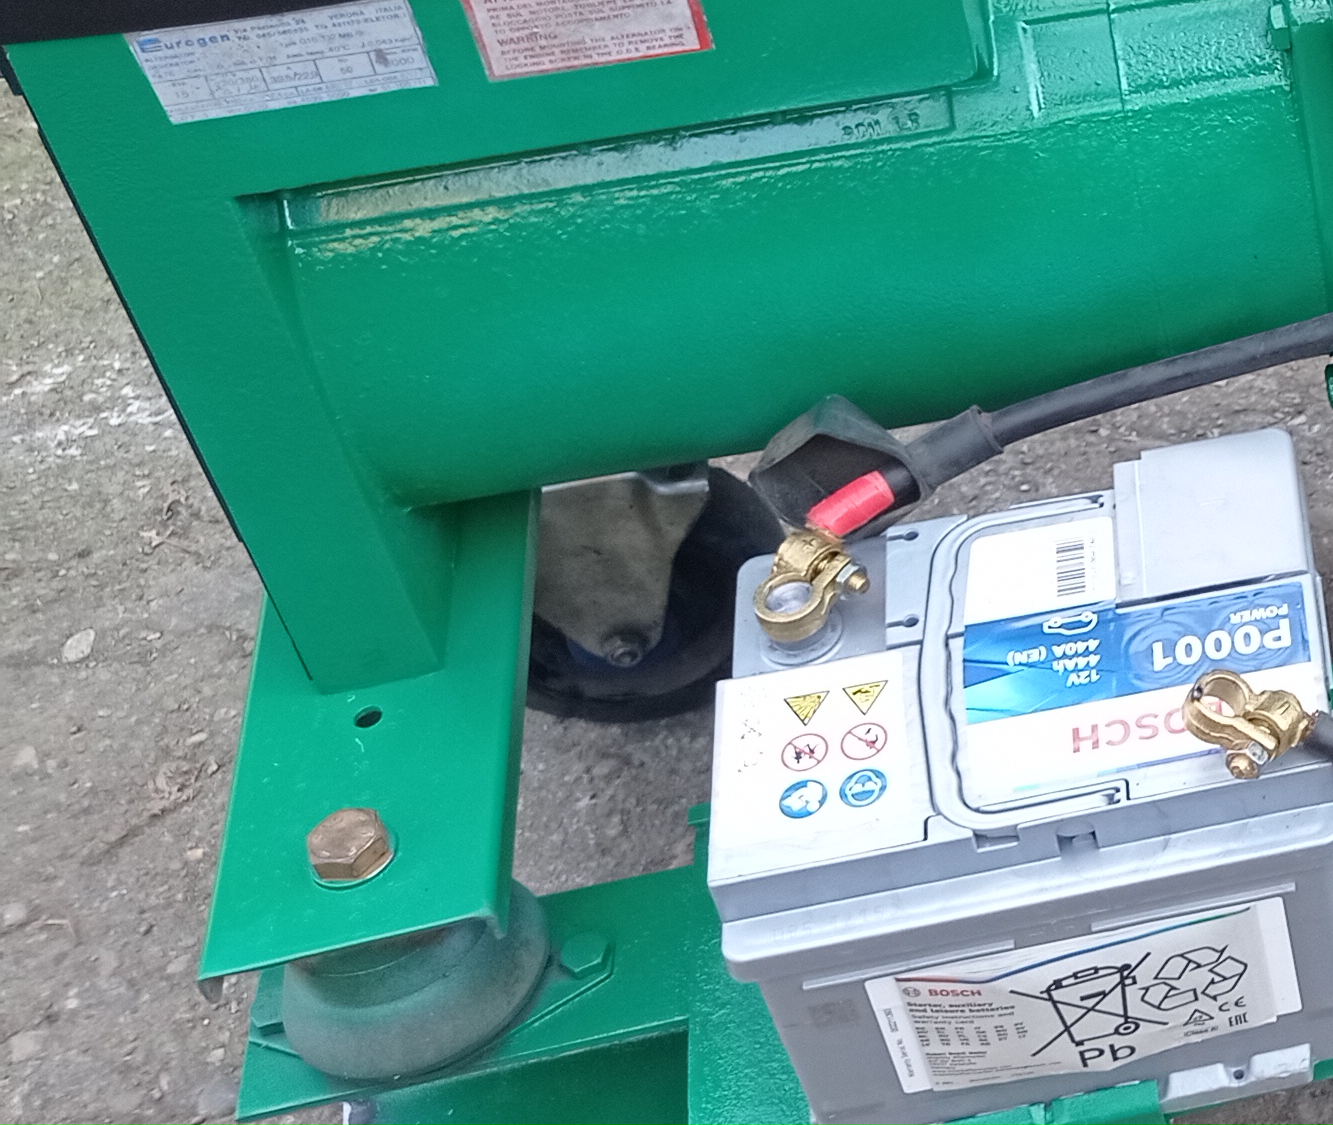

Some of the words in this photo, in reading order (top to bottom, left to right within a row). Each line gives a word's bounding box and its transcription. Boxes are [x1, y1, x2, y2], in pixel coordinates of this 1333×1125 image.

[136, 33, 231, 53] Eurogen
[497, 31, 558, 46] WARNING
[1230, 603, 1289, 624] POWER
[1052, 639, 1101, 657] 440A
[1152, 618, 1292, 672] P0001
[1006, 646, 1047, 667] (EN)
[1052, 655, 1101, 675] 44Ah
[1066, 672, 1100, 688] 12V
[928, 988, 982, 996] BOSCH
[1078, 1043, 1136, 1068] Pb
